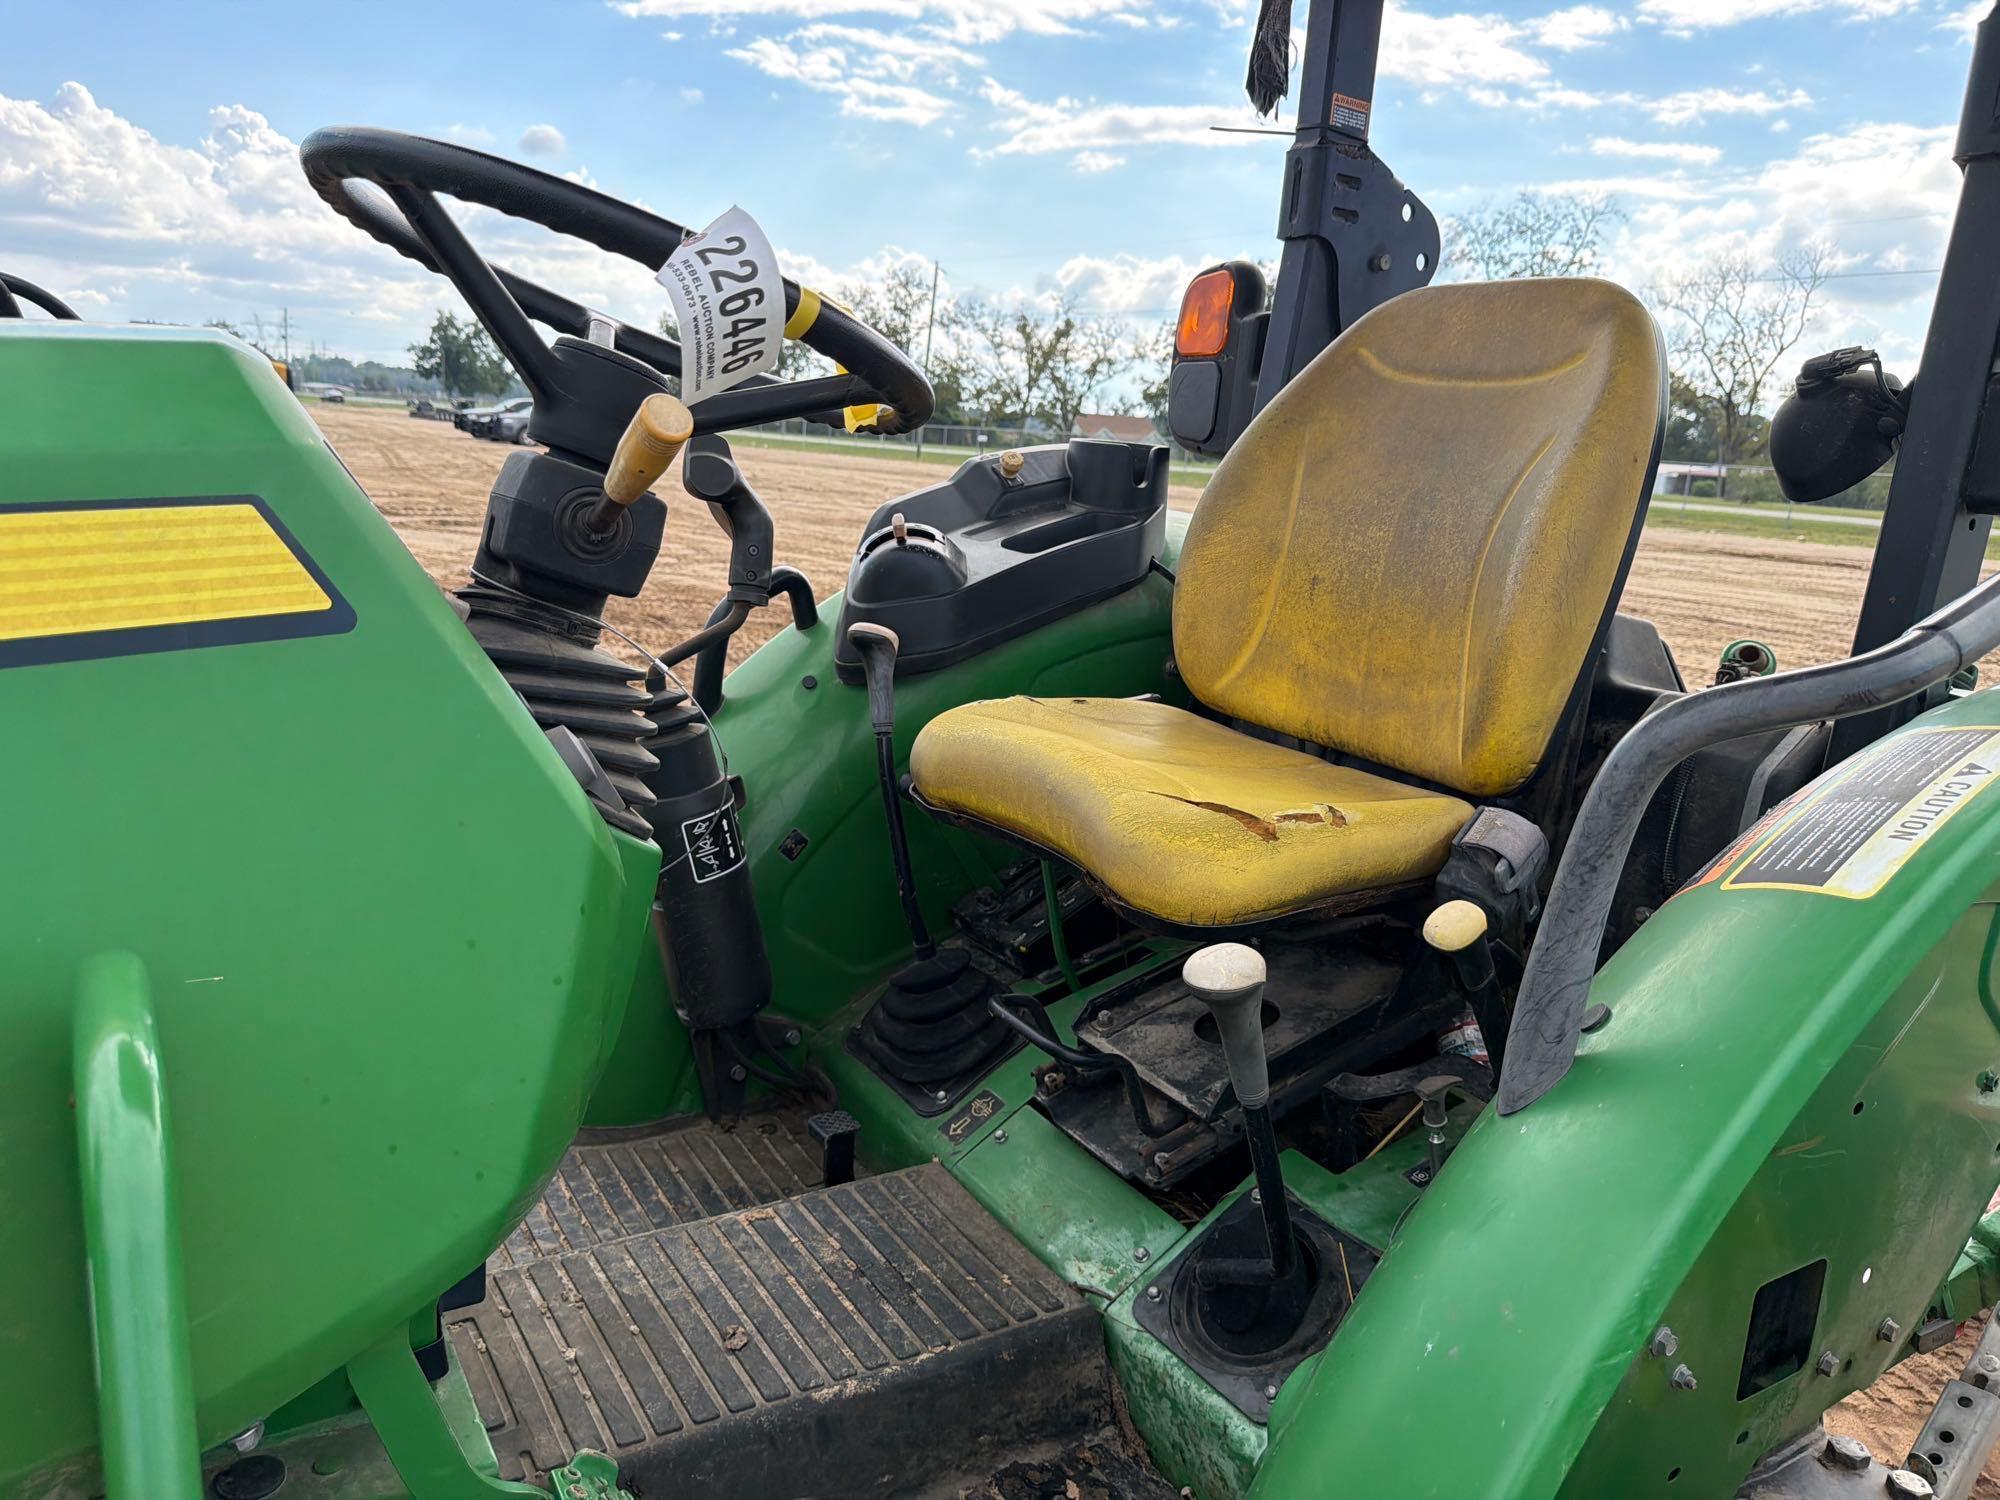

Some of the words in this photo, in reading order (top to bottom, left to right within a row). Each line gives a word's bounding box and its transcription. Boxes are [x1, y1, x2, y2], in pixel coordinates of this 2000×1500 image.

[1340, 97, 1369, 111] WARNING
[680, 258, 704, 292] REBEL
[698, 294, 714, 341] AUCTION
[706, 341, 716, 380] COMPANY
[694, 236, 767, 375] 226446
[1888, 781, 1973, 842] CAUTION
